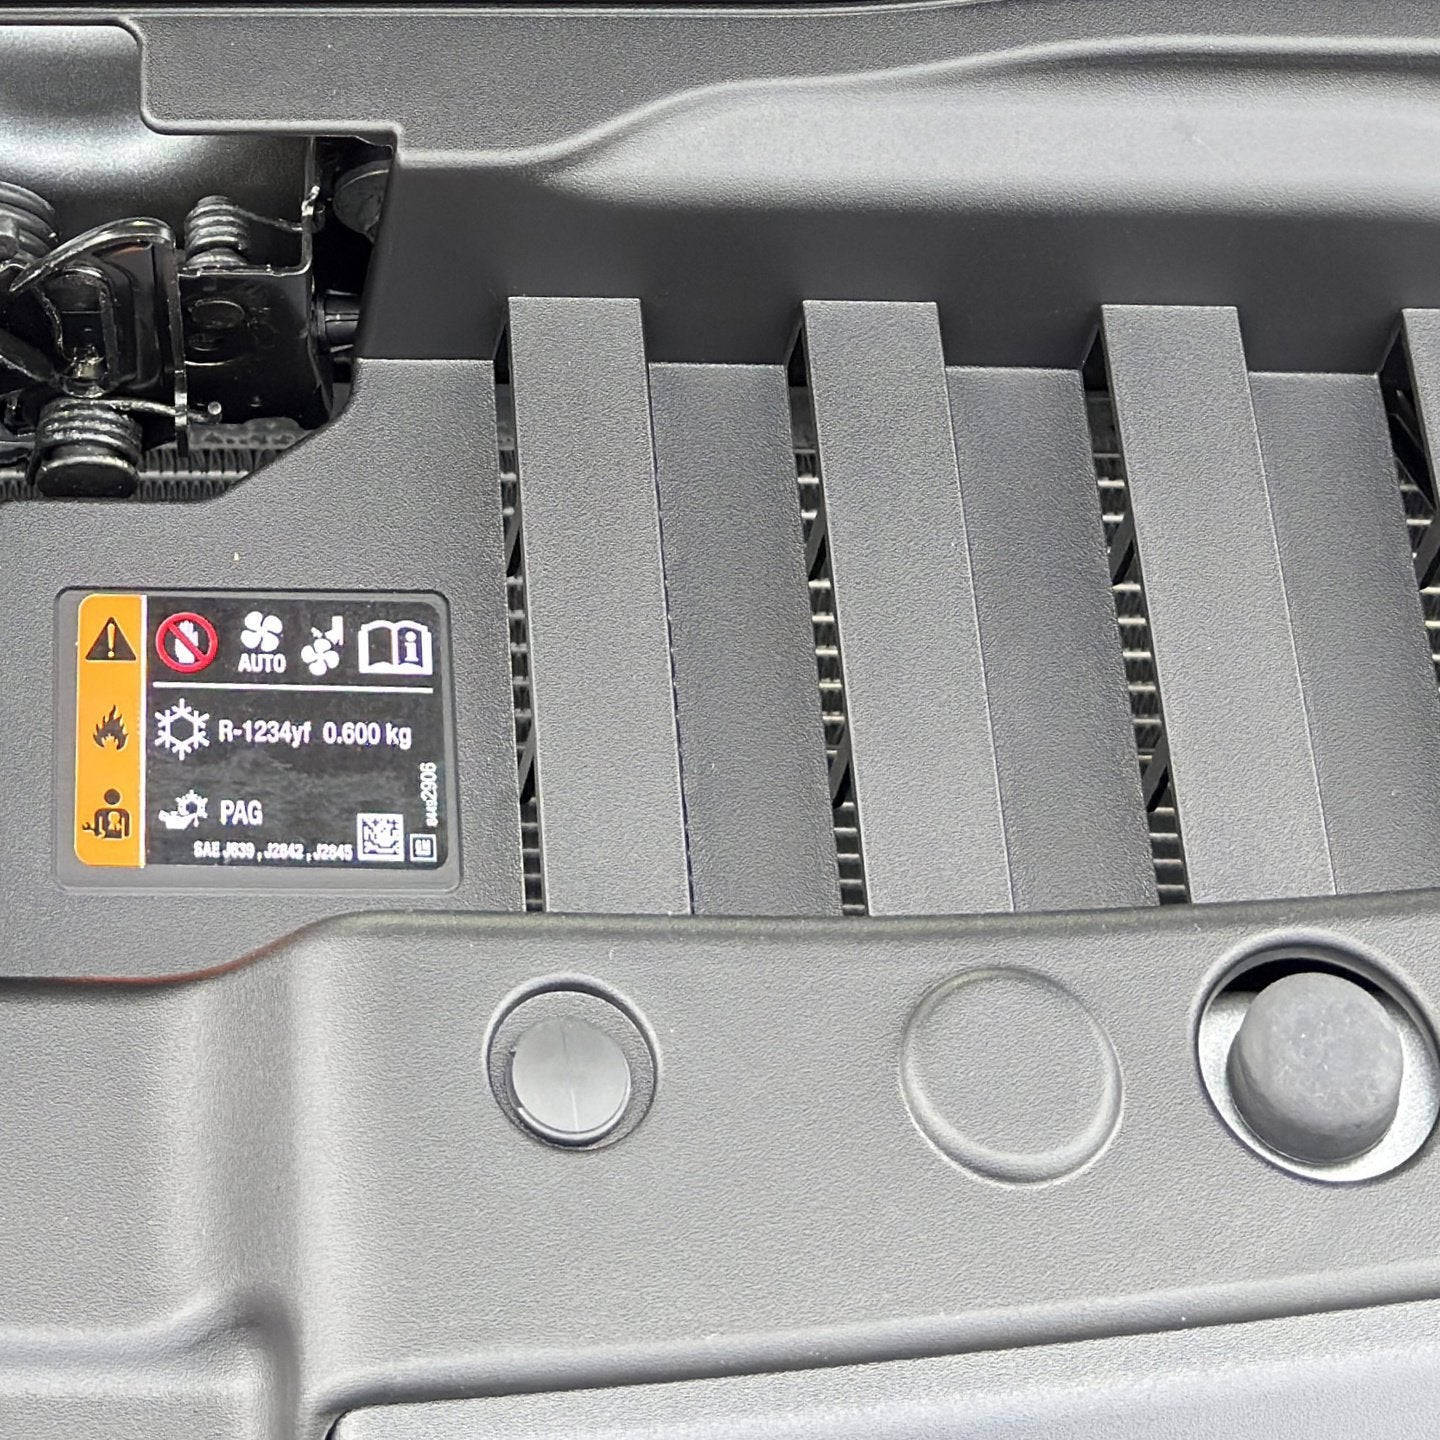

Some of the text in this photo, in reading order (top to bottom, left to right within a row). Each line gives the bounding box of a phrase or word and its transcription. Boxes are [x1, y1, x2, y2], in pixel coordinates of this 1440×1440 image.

[237, 653, 287, 674] AUTO
[218, 718, 413, 749] R-1234yf 0.600 kg
[220, 799, 264, 827] PAG
[193, 840, 220, 859] SAE
